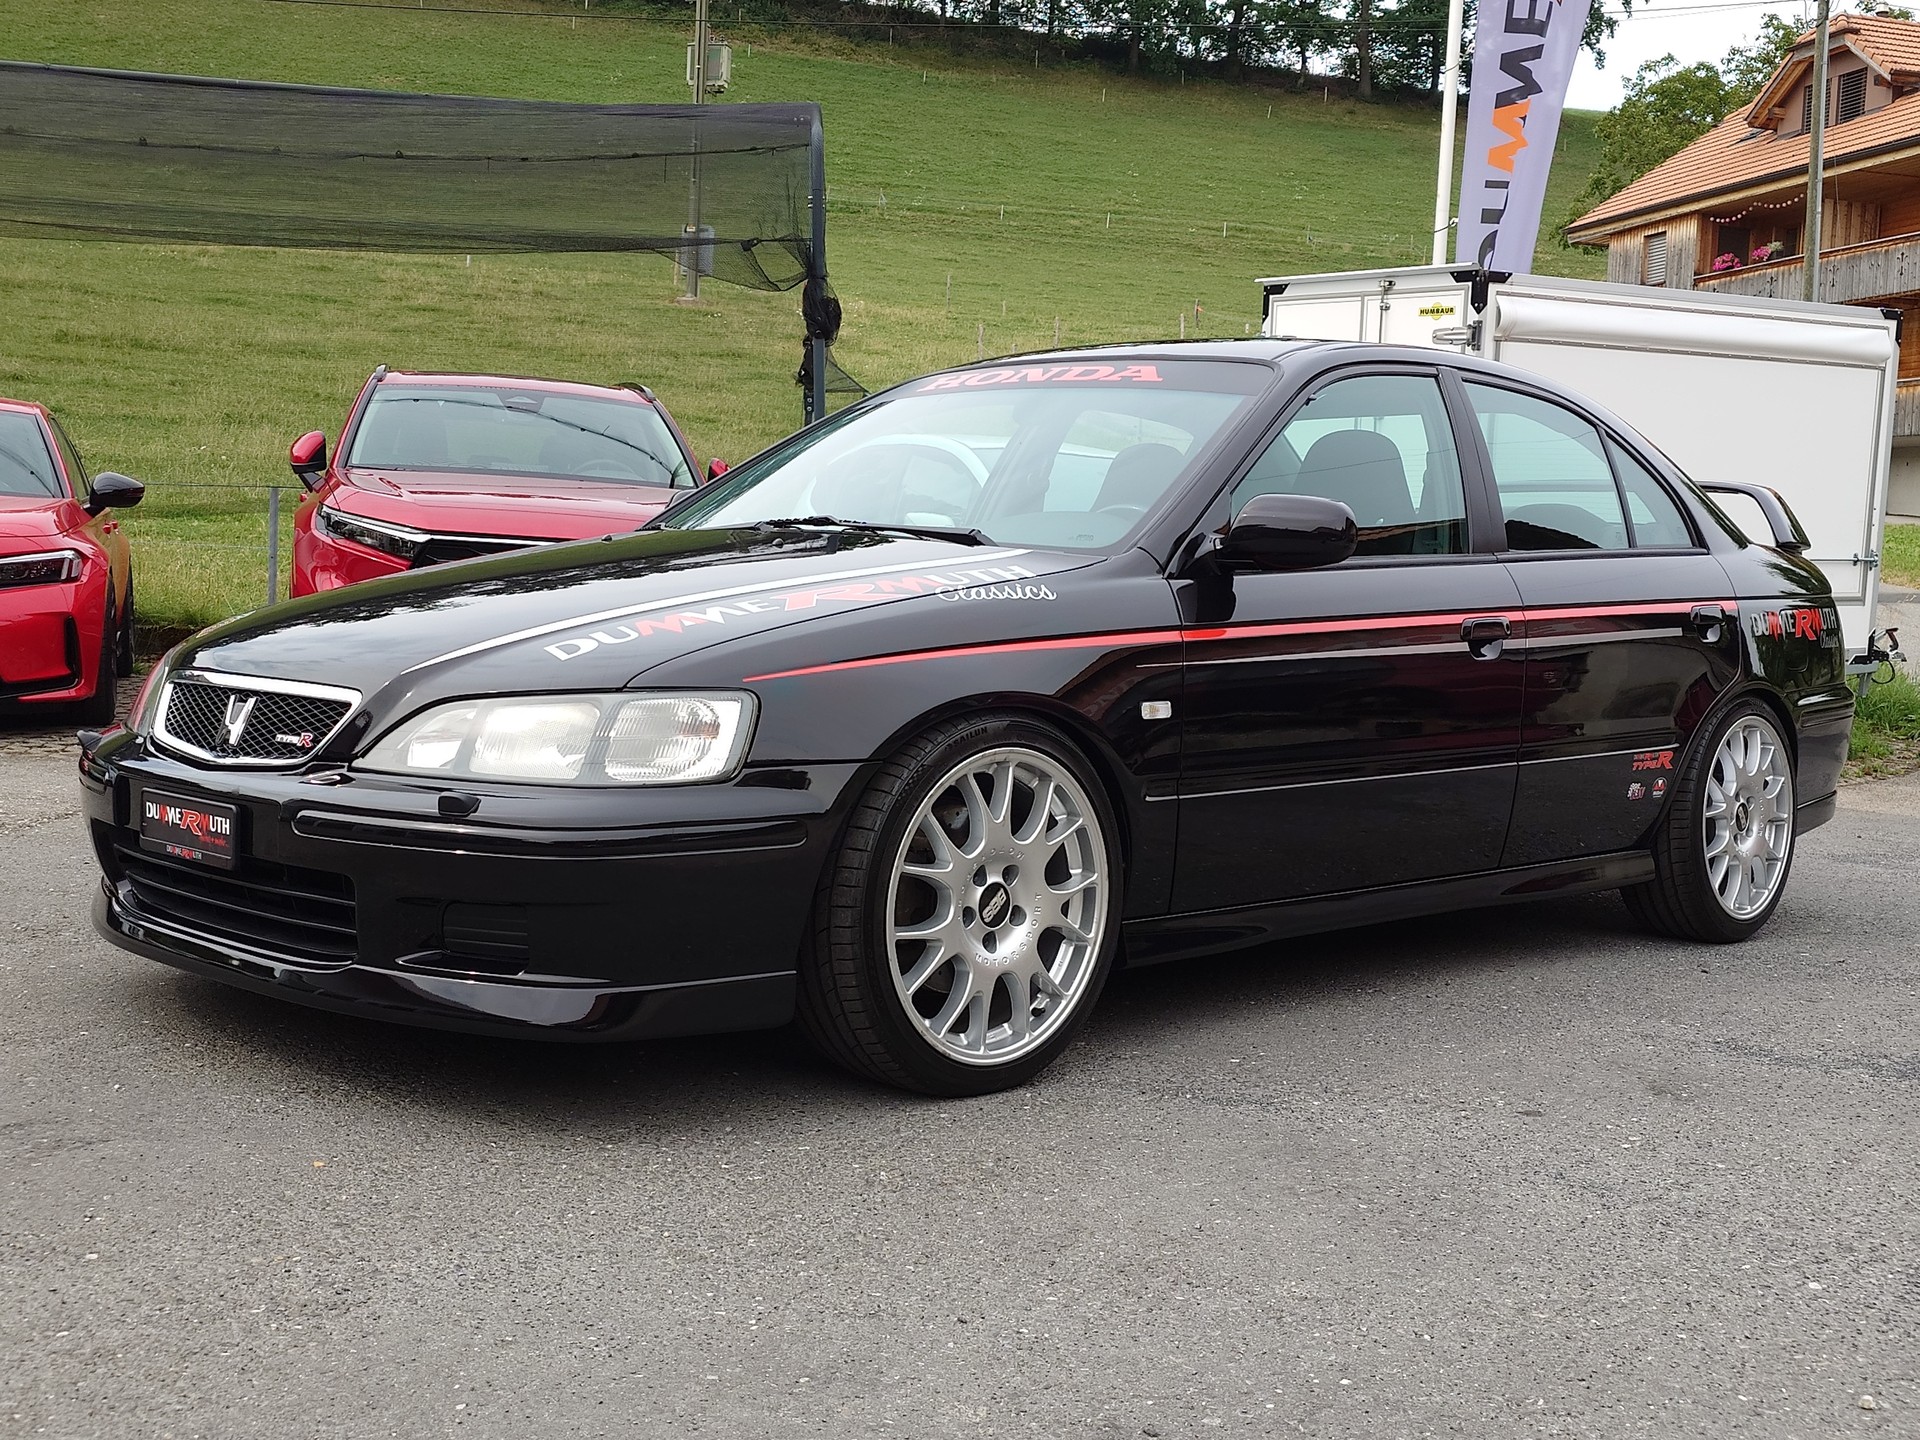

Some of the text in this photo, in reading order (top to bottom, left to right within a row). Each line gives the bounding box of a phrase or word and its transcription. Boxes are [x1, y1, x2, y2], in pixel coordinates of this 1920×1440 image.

[1419, 307, 1454, 315] HUMBAUR
[916, 365, 1164, 393] HONDA
[934, 583, 1058, 602] Classics
[543, 565, 1037, 662] DUMMERMUTH
[1751, 607, 1838, 642] DUMMERMUTH
[145, 801, 231, 836] DUMMERMUTH
